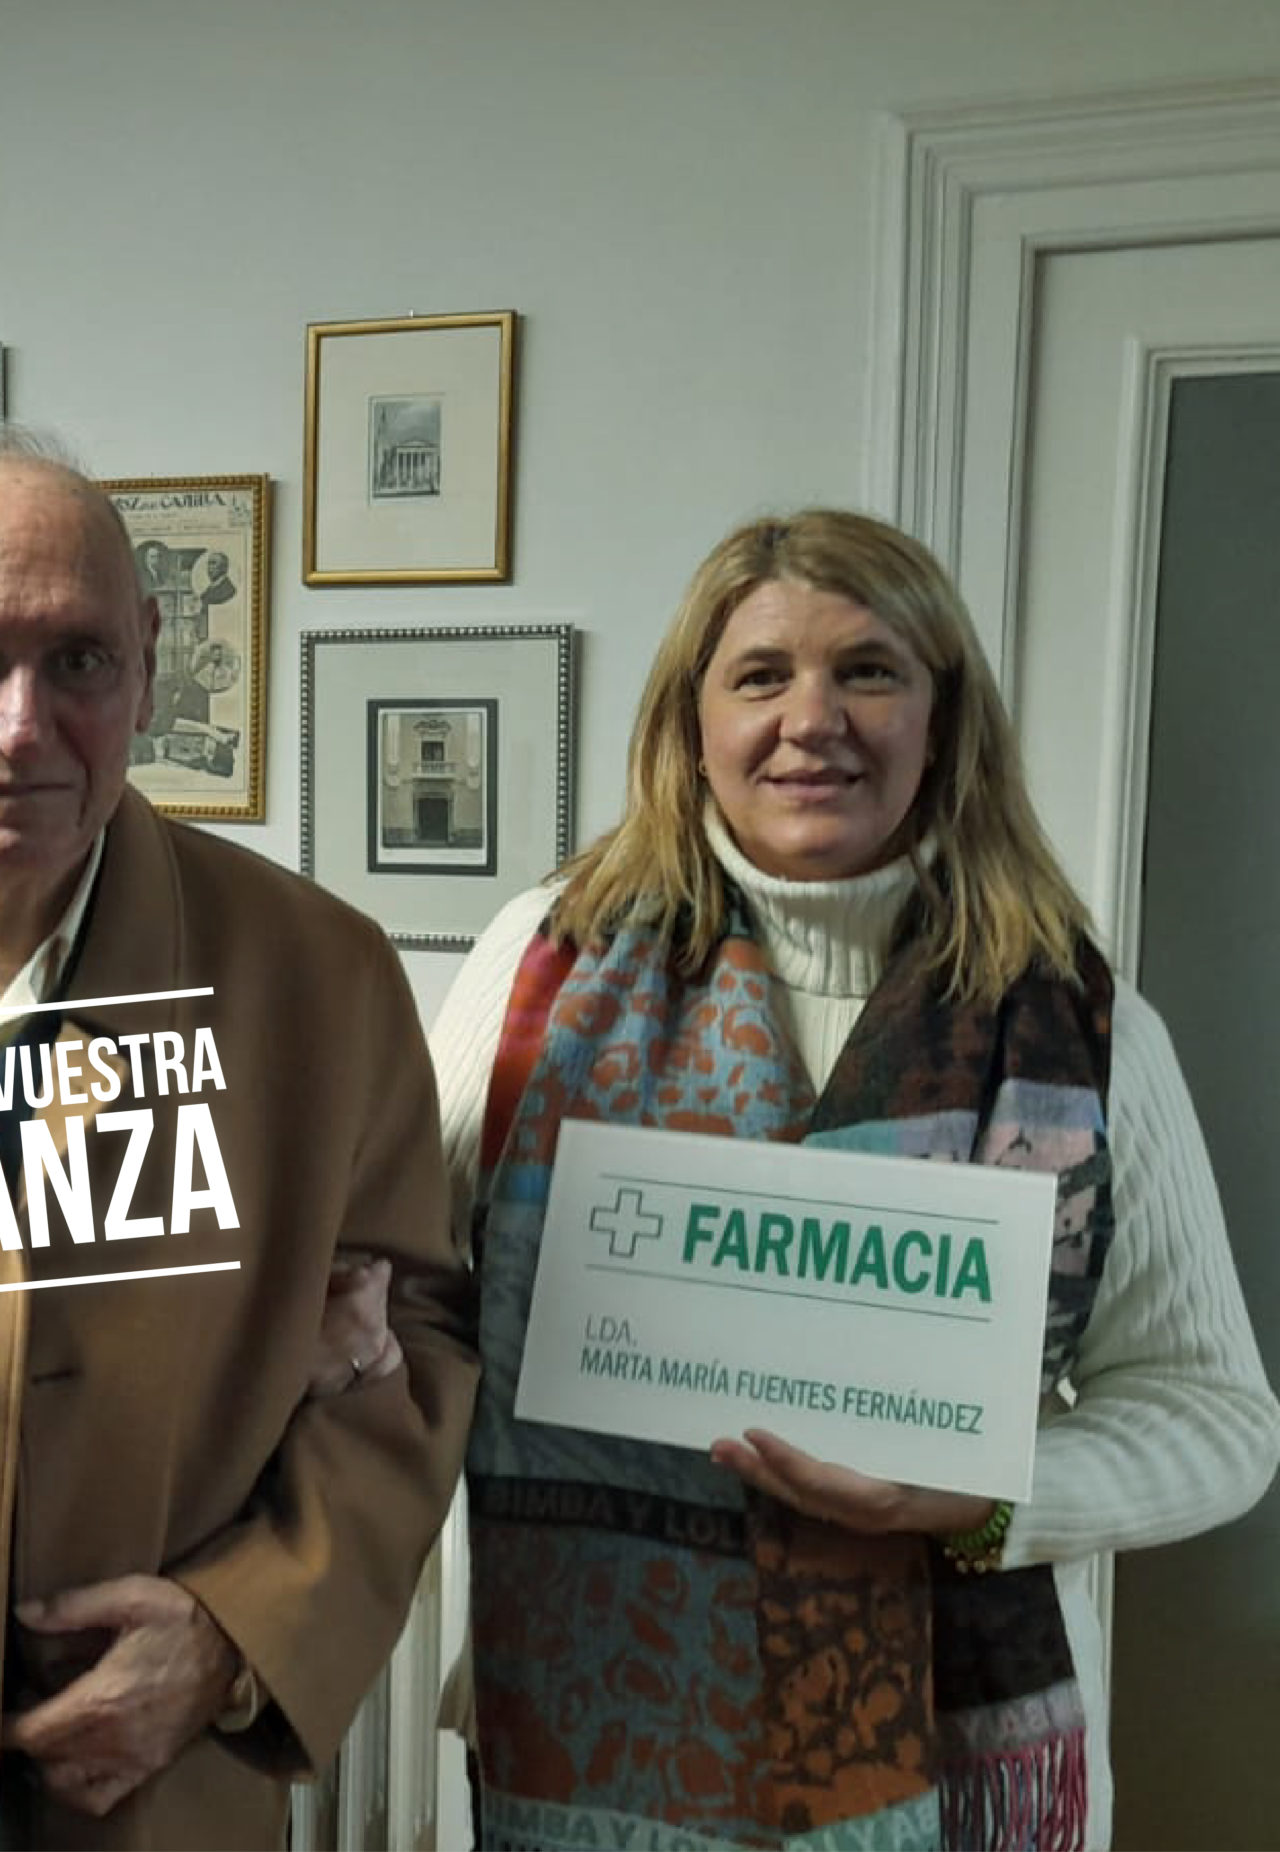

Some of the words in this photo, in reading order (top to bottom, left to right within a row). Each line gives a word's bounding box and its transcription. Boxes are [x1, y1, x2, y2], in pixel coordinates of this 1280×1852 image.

[682, 1203, 993, 1303] FARMACIA
[585, 1313, 638, 1347] LDA.
[580, 1347, 654, 1385] MARTA
[658, 1357, 730, 1397] MARÍA
[735, 1368, 837, 1412] FUENTES
[842, 1386, 984, 1435] FERNÁNDEZ
[664, 1502, 744, 1556] LOL
